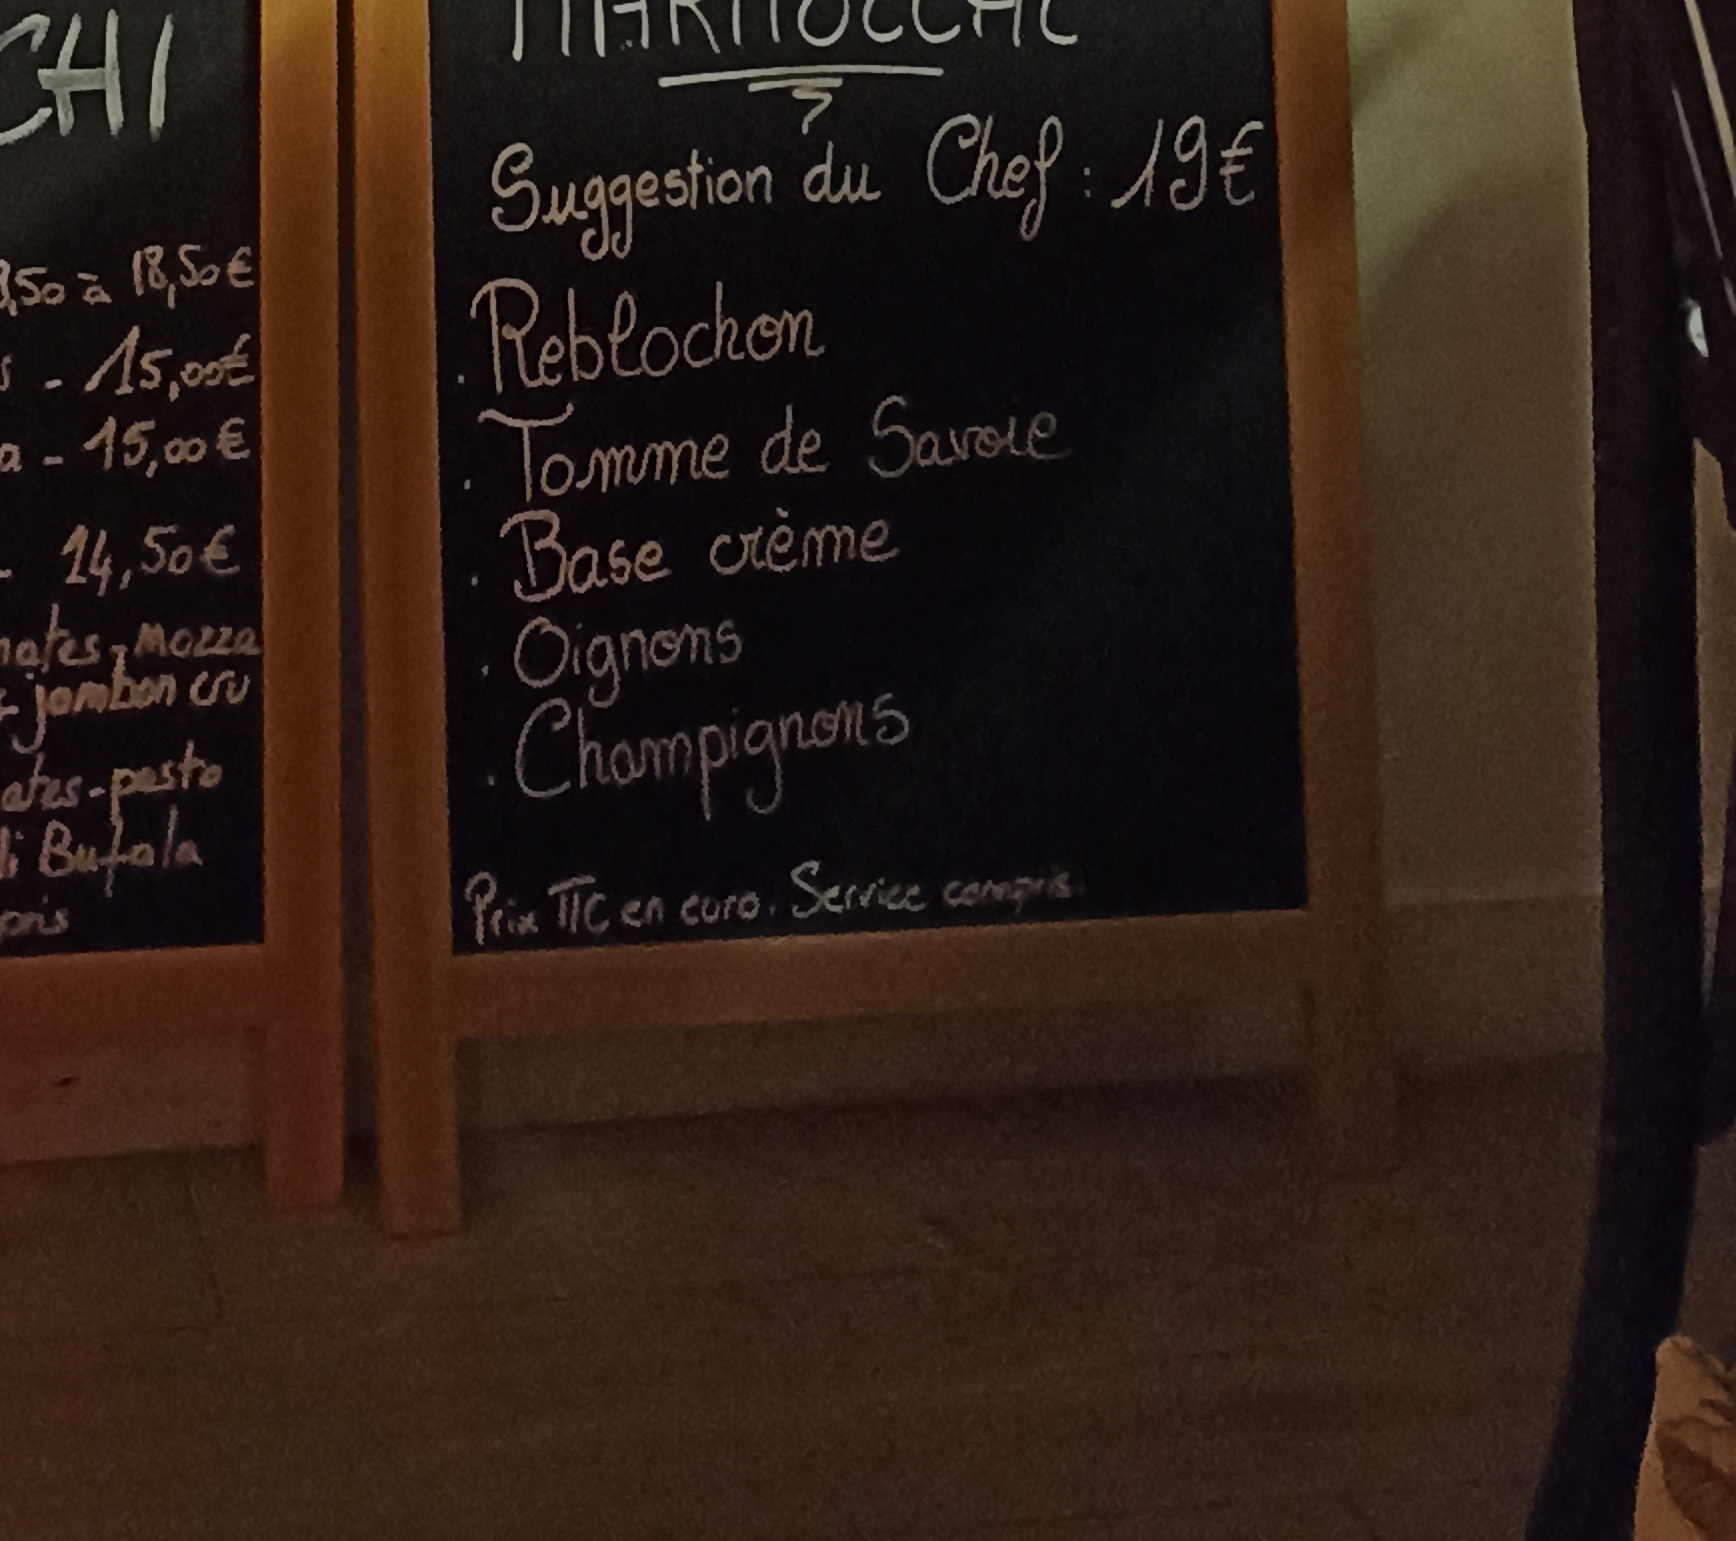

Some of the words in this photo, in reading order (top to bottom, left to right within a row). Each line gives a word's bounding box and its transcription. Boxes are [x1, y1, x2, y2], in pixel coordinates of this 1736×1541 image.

[489, 140, 773, 262] Suggestion
[802, 140, 882, 206] du
[926, 113, 1064, 241] Chef
[1110, 114, 1265, 212] 19€
[83, 324, 256, 402] 15,00€
[470, 276, 826, 395] Reblochon
[478, 401, 730, 502] Tomme
[760, 404, 829, 477] de
[867, 393, 1072, 479] Savoie
[61, 522, 242, 598] 14,50€
[499, 508, 672, 604] Base
[708, 506, 902, 576] crème
[190, 669, 252, 708] cru
[512, 615, 744, 709] Oignons
[515, 692, 911, 821] Champignons
[38, 803, 204, 898] Bufala
[547, 873, 610, 936] TTC
[620, 892, 665, 926] en
[789, 859, 928, 921] Service
